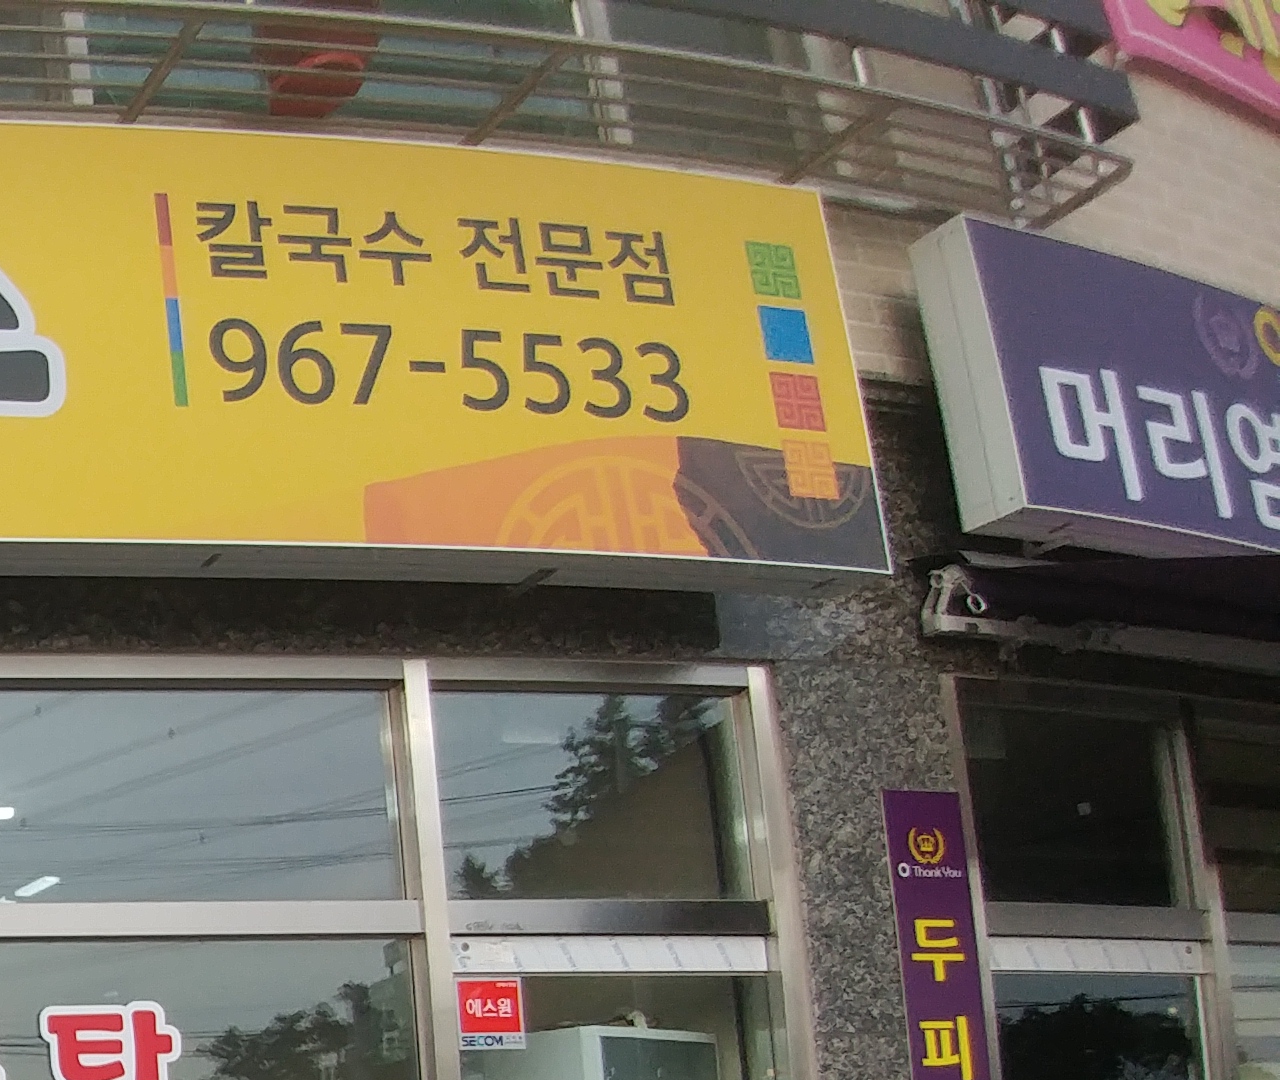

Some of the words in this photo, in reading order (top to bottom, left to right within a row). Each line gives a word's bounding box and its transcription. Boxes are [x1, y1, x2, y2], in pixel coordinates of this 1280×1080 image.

[195, 200, 433, 286] 칼국수
[455, 215, 678, 307] 전문점
[207, 315, 690, 423] 967-5533
[465, 997, 513, 1018] 에스원
[461, 1035, 504, 1047] SECOM
